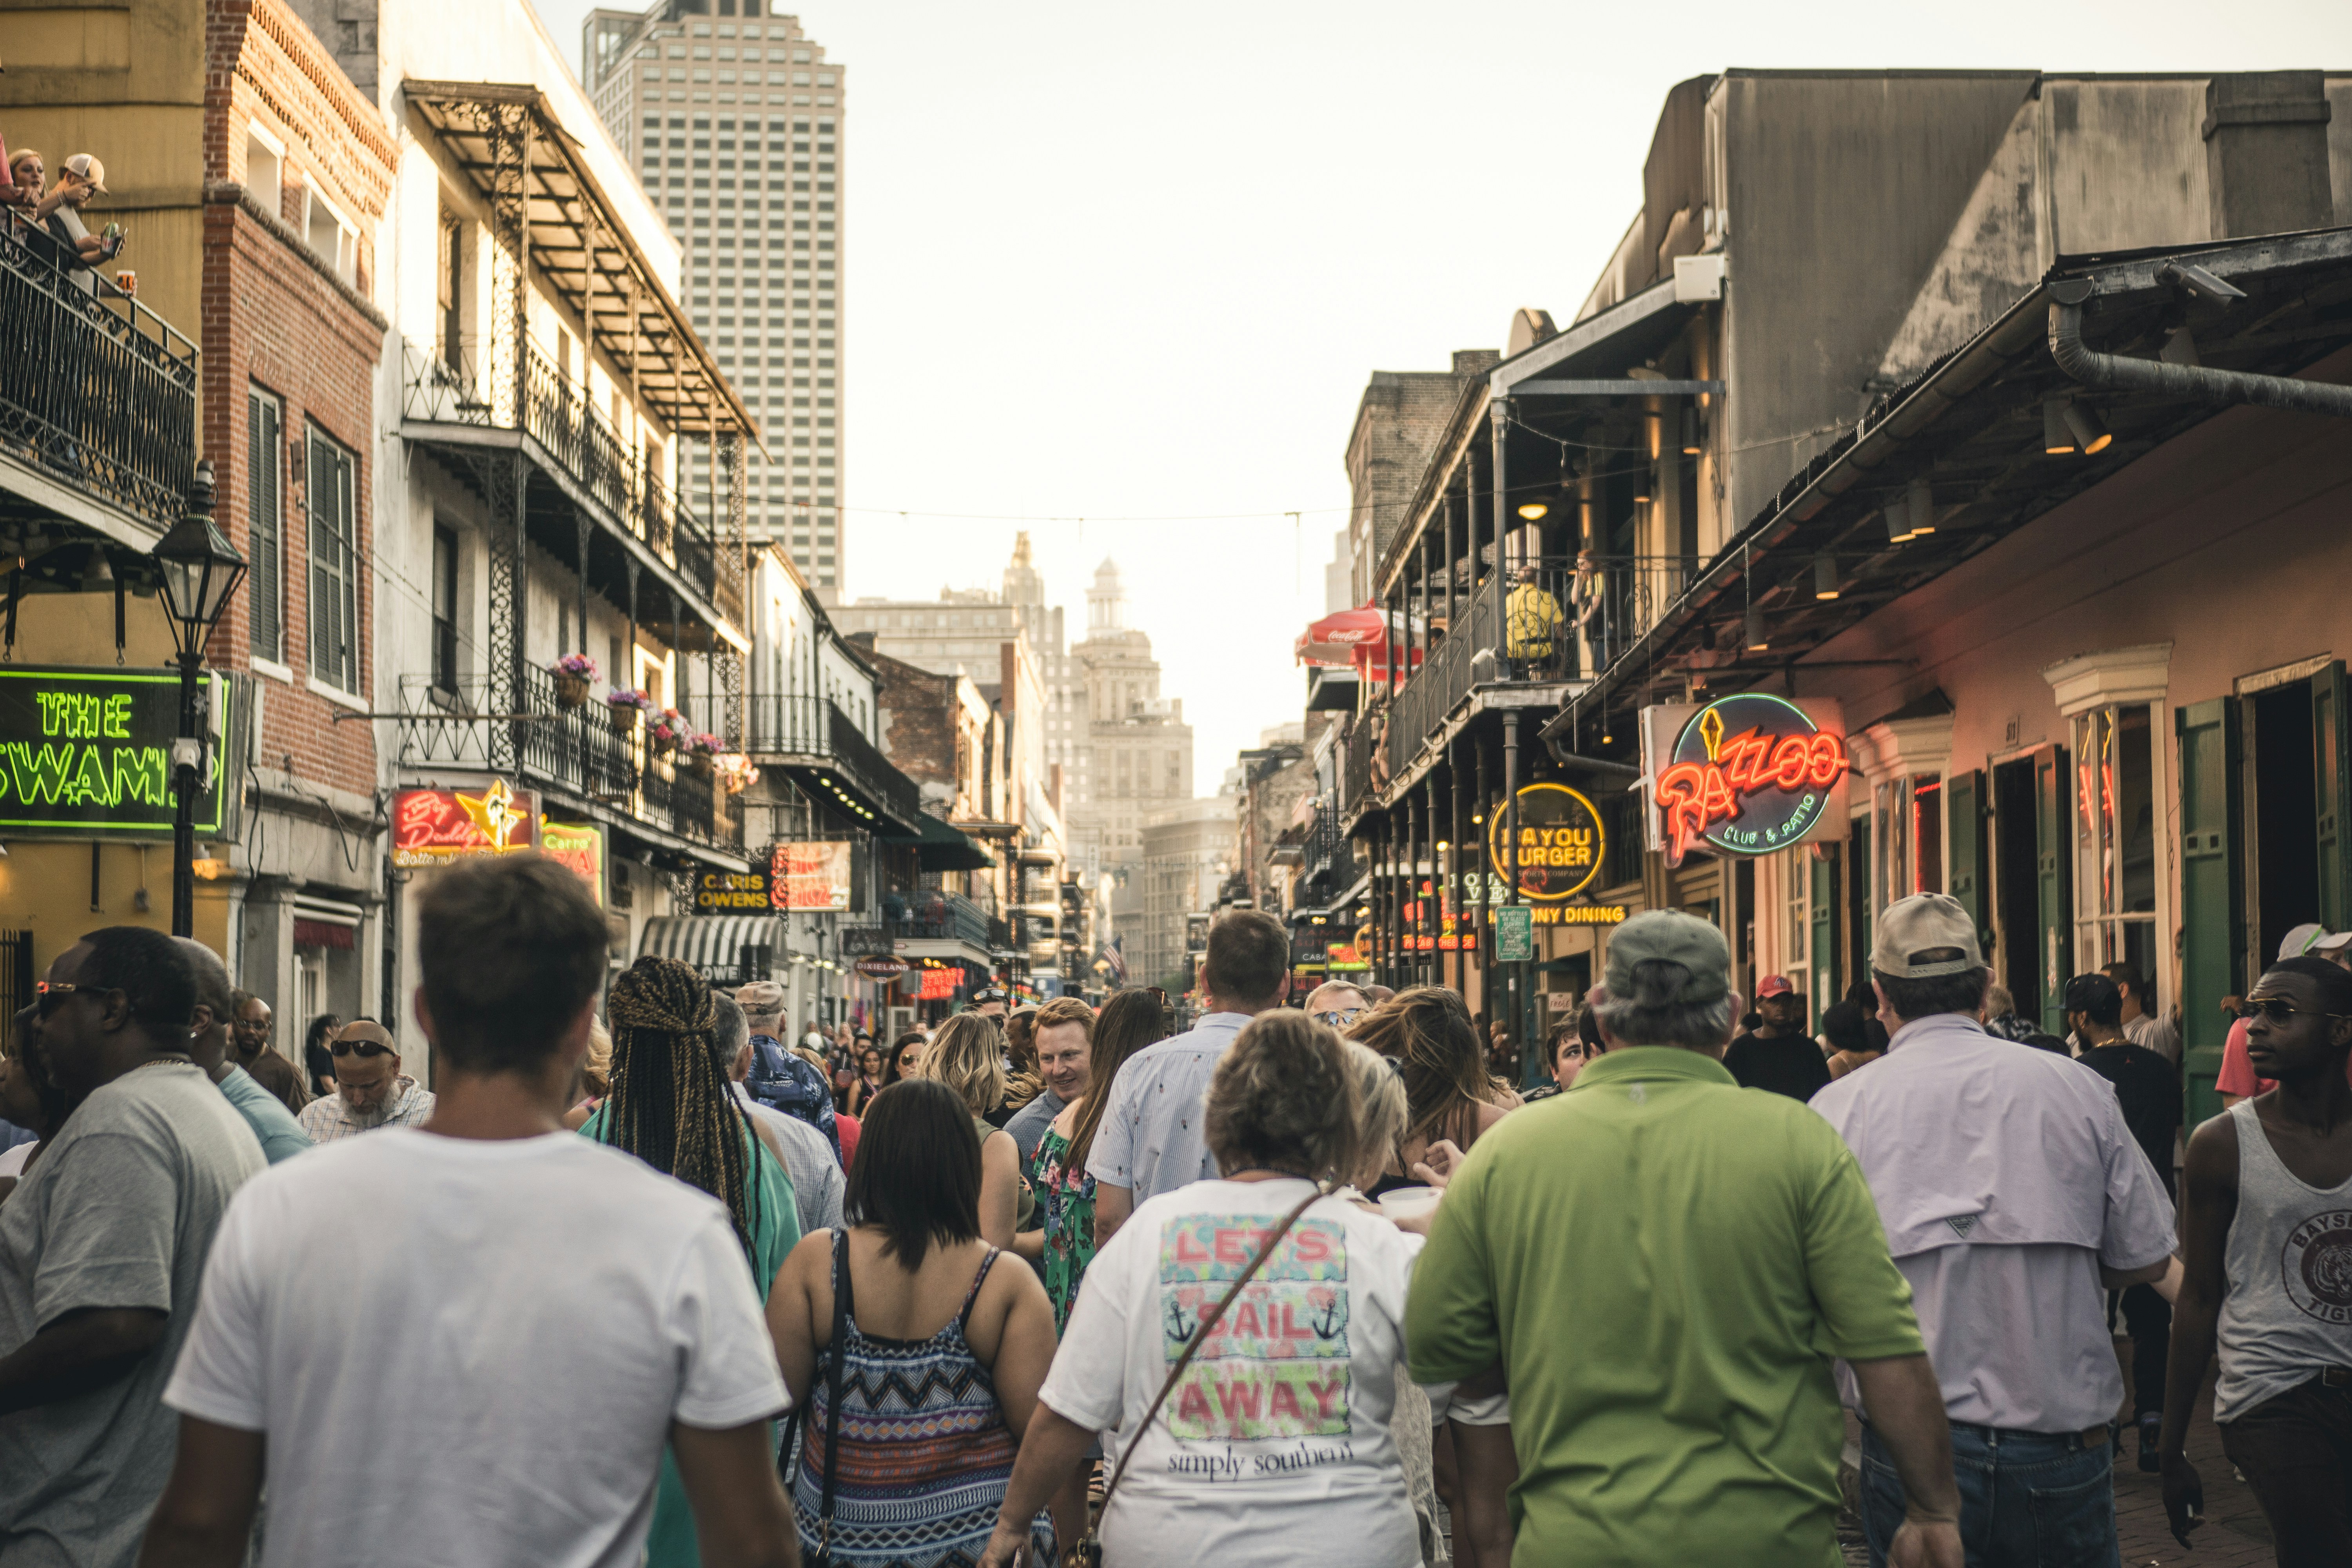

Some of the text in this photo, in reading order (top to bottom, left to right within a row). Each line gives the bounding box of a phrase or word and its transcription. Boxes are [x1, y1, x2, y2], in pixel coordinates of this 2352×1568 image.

[37, 692, 132, 738] THE
[0, 741, 220, 808] WAM
[403, 791, 452, 825] Big
[1655, 725, 1849, 860] RAZZOO
[1724, 793, 1817, 846] CLUB & PATIO
[699, 892, 768, 907] OWENS
[831, 896, 848, 905] Club
[1565, 906, 1625, 923] DINING
[702, 966, 740, 980] OWE
[857, 963, 909, 971] DIXIELAND
[2292, 1214, 2352, 1249] BAYS
[1197, 1301, 1315, 1340] SAIL
[2307, 1297, 2352, 1321] TIG
[1177, 1380, 1342, 1422] AWAY
[1167, 1442, 1354, 1481] simply southern
